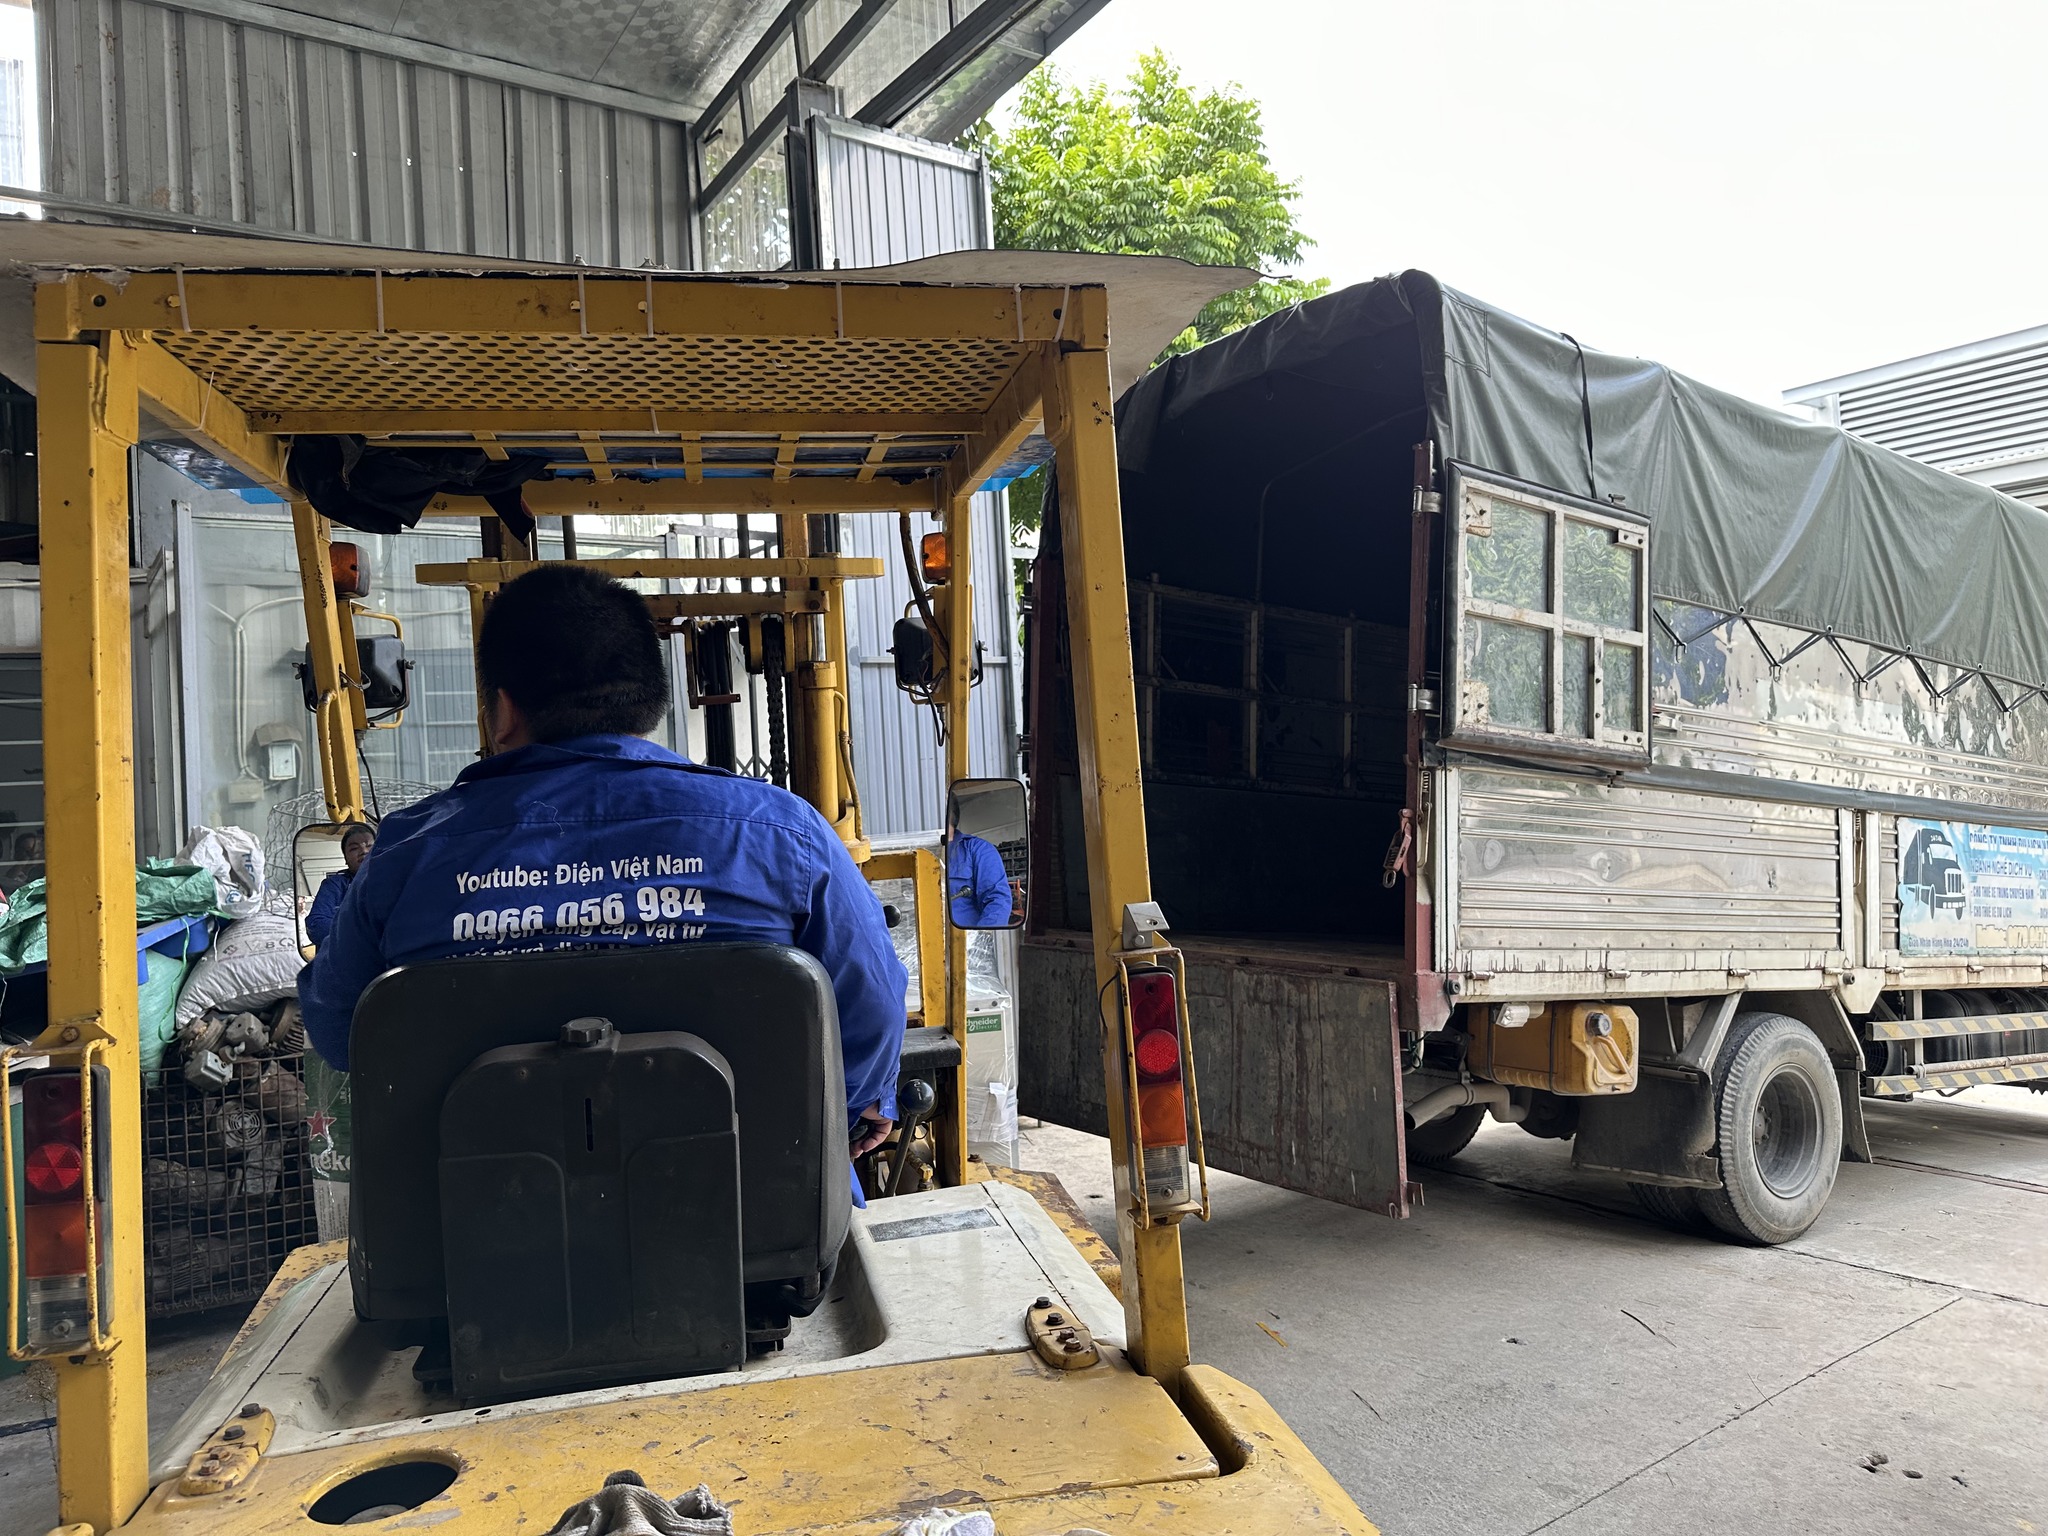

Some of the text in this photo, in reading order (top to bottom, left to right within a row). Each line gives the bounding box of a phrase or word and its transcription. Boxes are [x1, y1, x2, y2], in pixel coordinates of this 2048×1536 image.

[456, 854, 703, 894] Youtube: Điện Việt Nam
[453, 886, 706, 941] 0966 056 984
